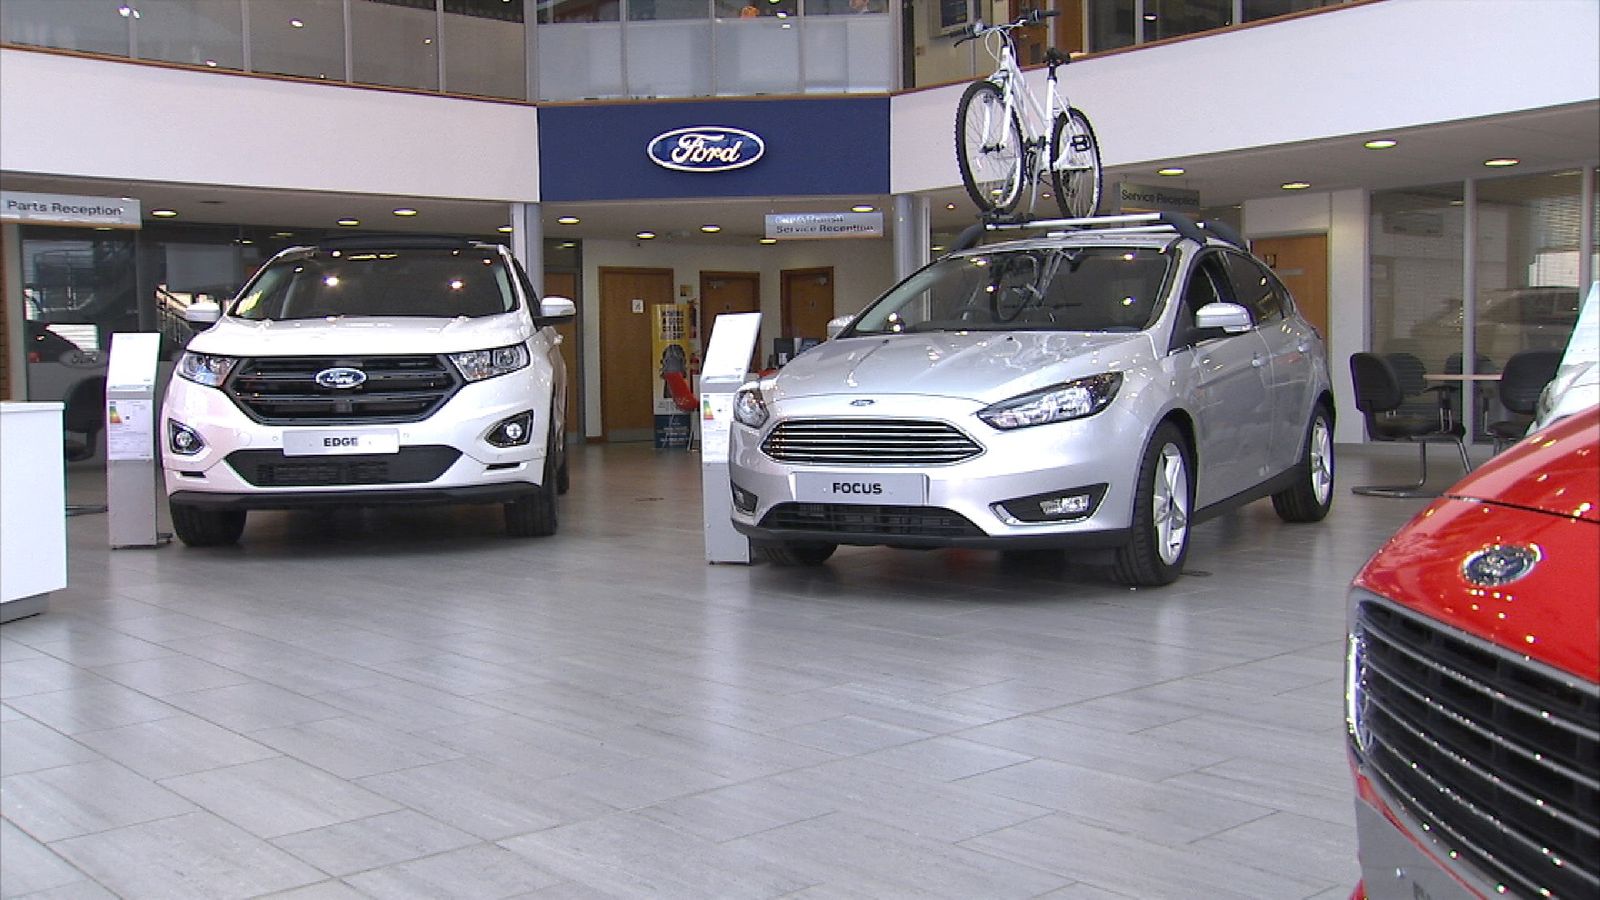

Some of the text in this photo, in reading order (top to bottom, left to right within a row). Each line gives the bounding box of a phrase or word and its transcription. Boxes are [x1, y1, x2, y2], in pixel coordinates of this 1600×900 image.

[671, 134, 743, 163] Ford
[1121, 189, 1155, 203] Service
[6, 199, 122, 216] Parts Reception
[776, 223, 874, 234] Service Reception
[323, 437, 359, 447] EDGE
[832, 482, 883, 494] FOCUS
